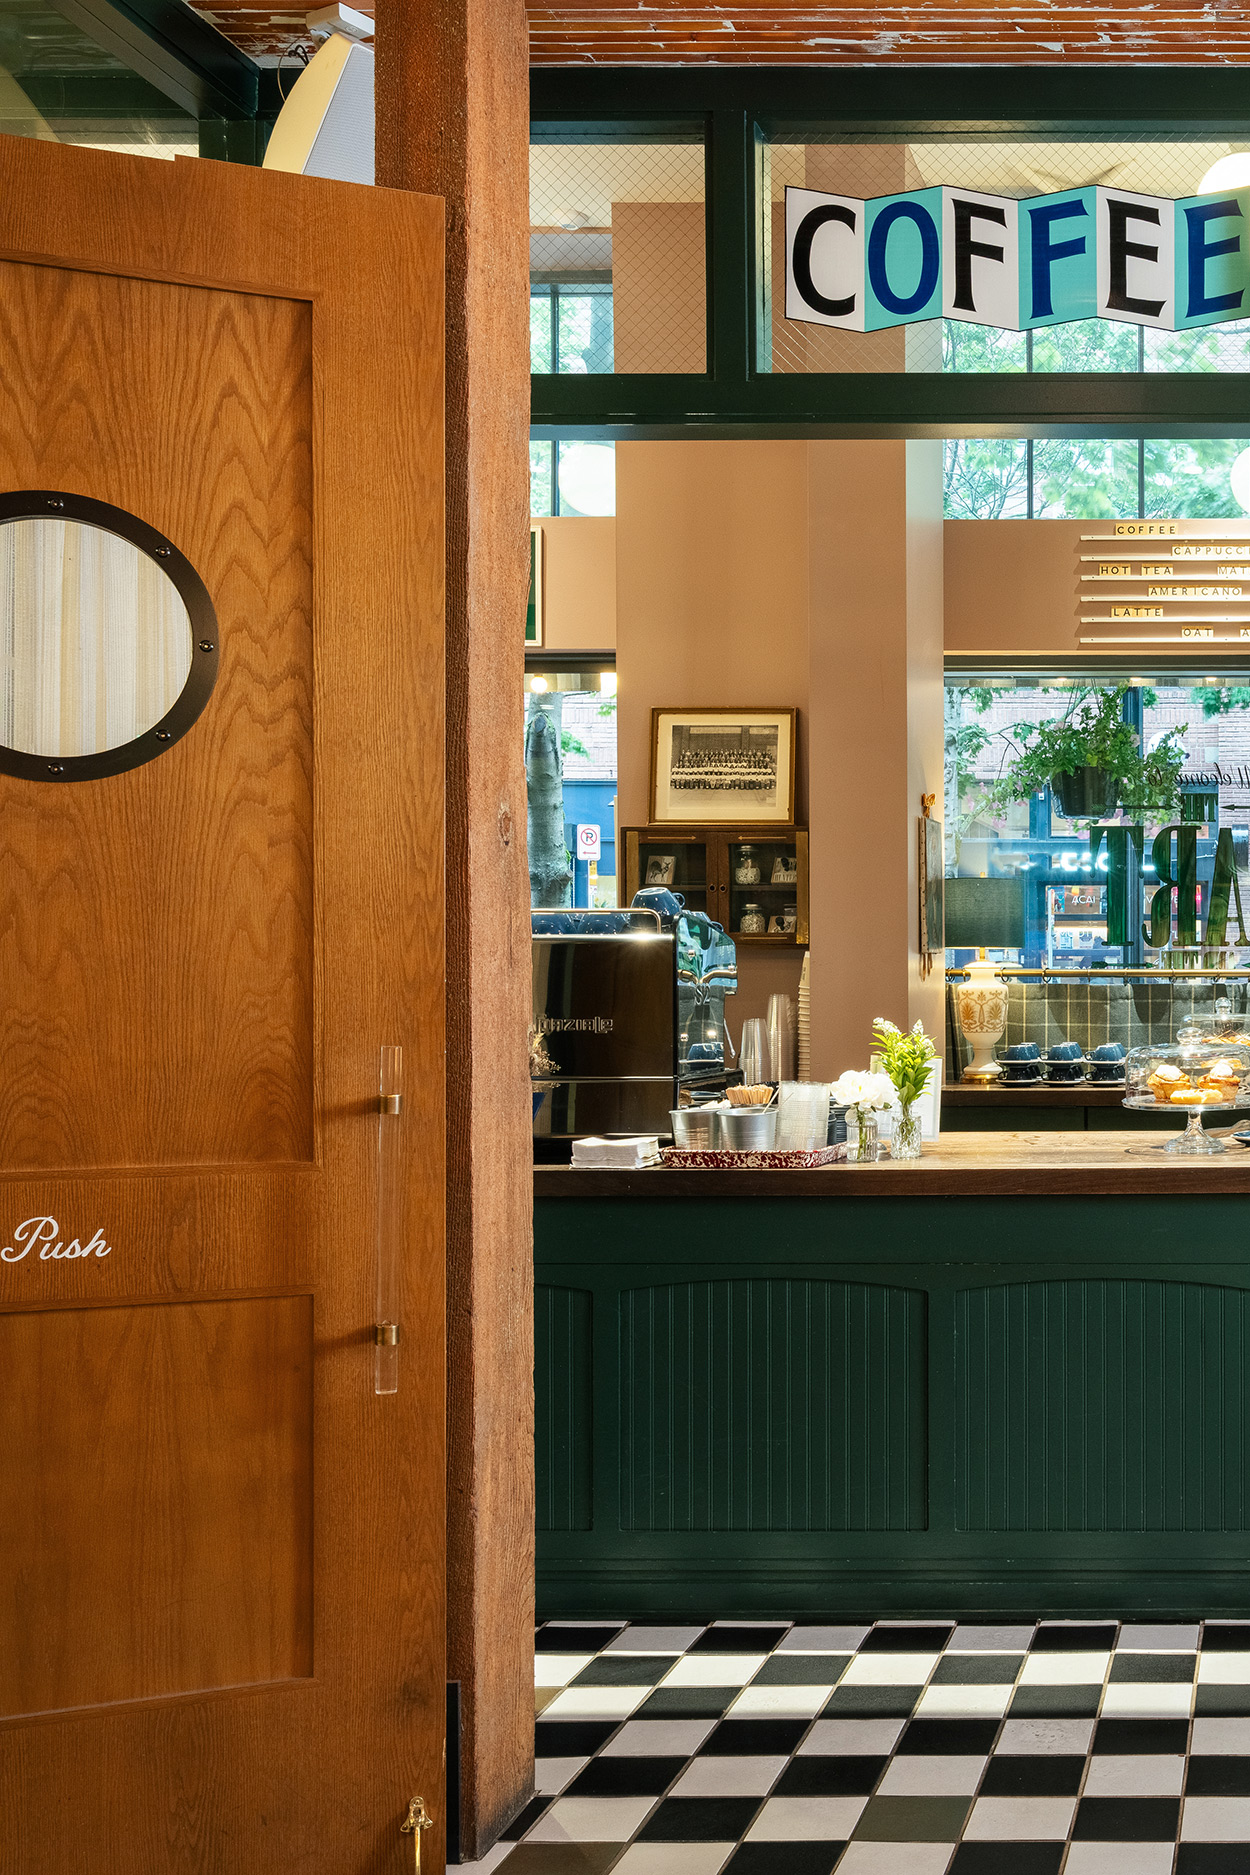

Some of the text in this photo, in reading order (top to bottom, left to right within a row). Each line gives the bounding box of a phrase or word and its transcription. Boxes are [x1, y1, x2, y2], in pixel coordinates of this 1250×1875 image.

[792, 198, 1246, 320] COFFEE
[1117, 525, 1176, 535] COFFEE
[1100, 566, 1172, 575] HOT TEA
[1150, 587, 1241, 596] AMERICANO
[1113, 608, 1161, 617] LATTE
[1183, 628, 1213, 637] OAT
[0, 1215, 112, 1262] Push
